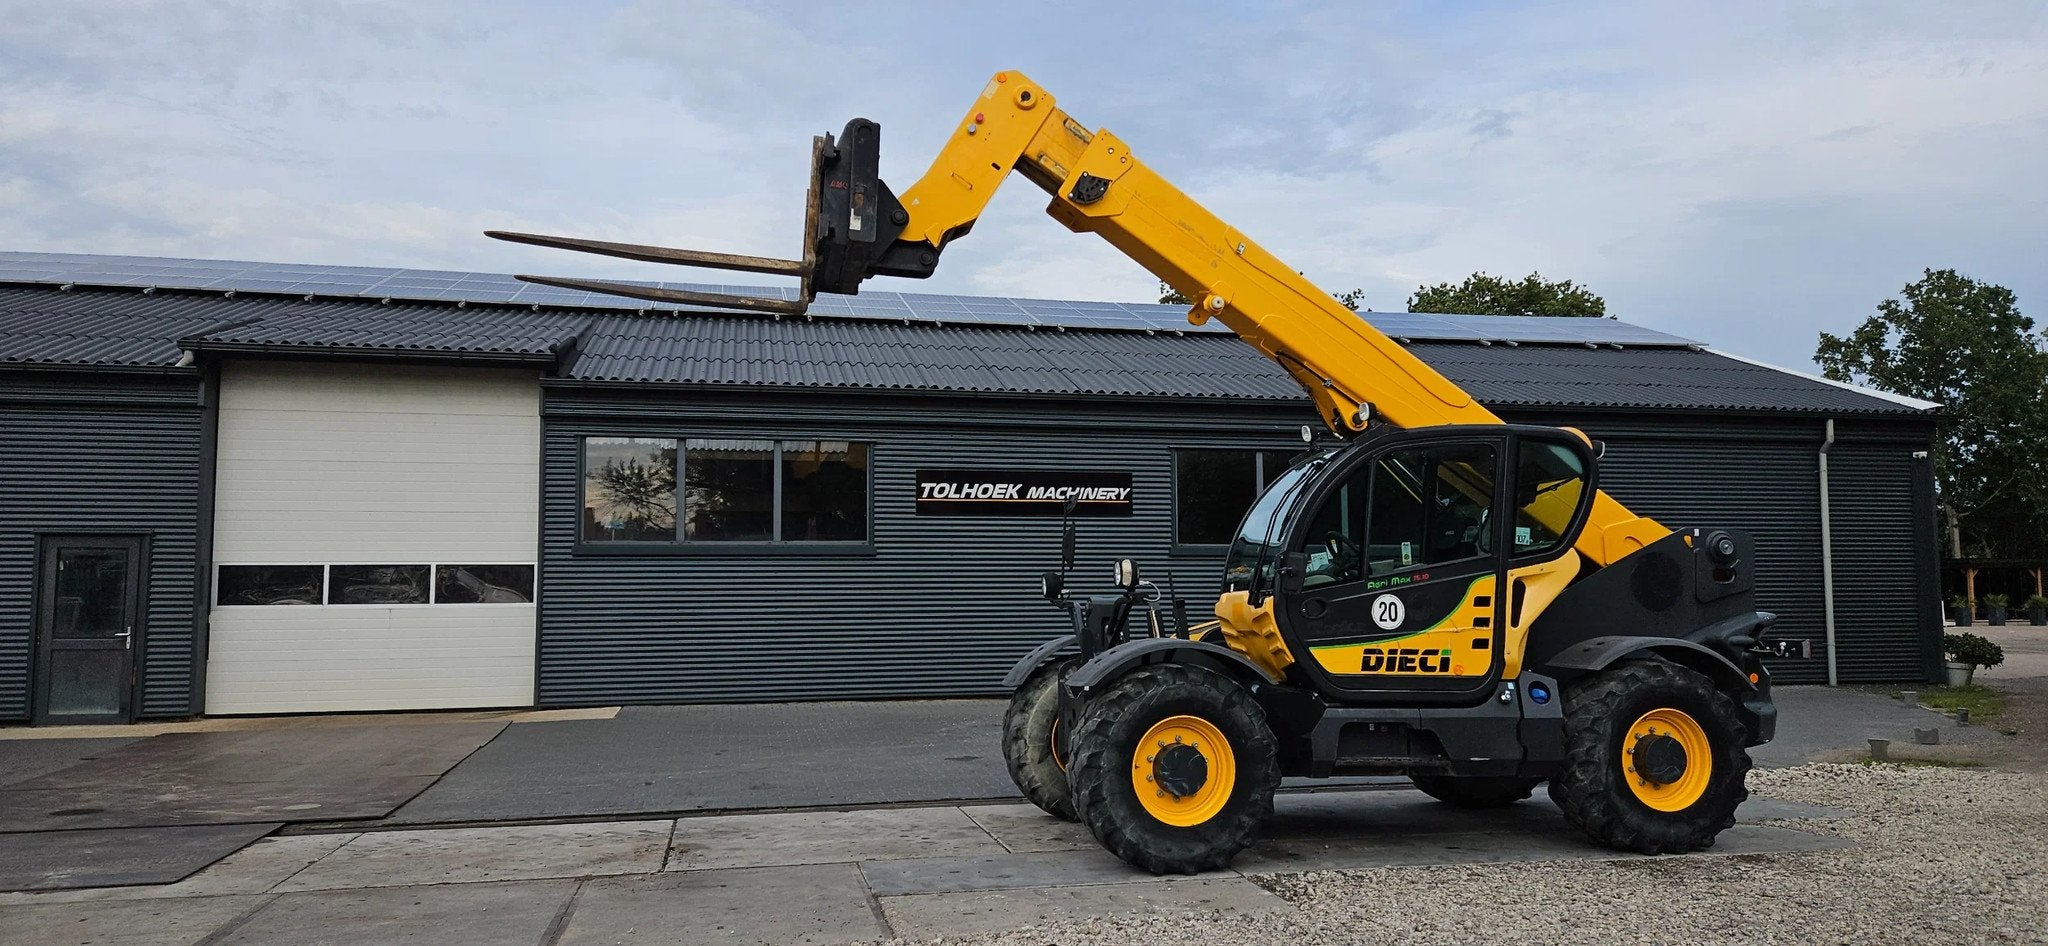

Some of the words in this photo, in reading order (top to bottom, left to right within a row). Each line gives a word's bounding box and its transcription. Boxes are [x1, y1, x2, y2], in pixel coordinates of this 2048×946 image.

[920, 482, 1022, 499] TOLHOEK
[1026, 486, 1131, 500] MACHINERY
[1367, 579, 1388, 589] Agri
[1391, 576, 1411, 586] Max
[1378, 601, 1398, 622] 20
[1360, 648, 1452, 672] DIECI
